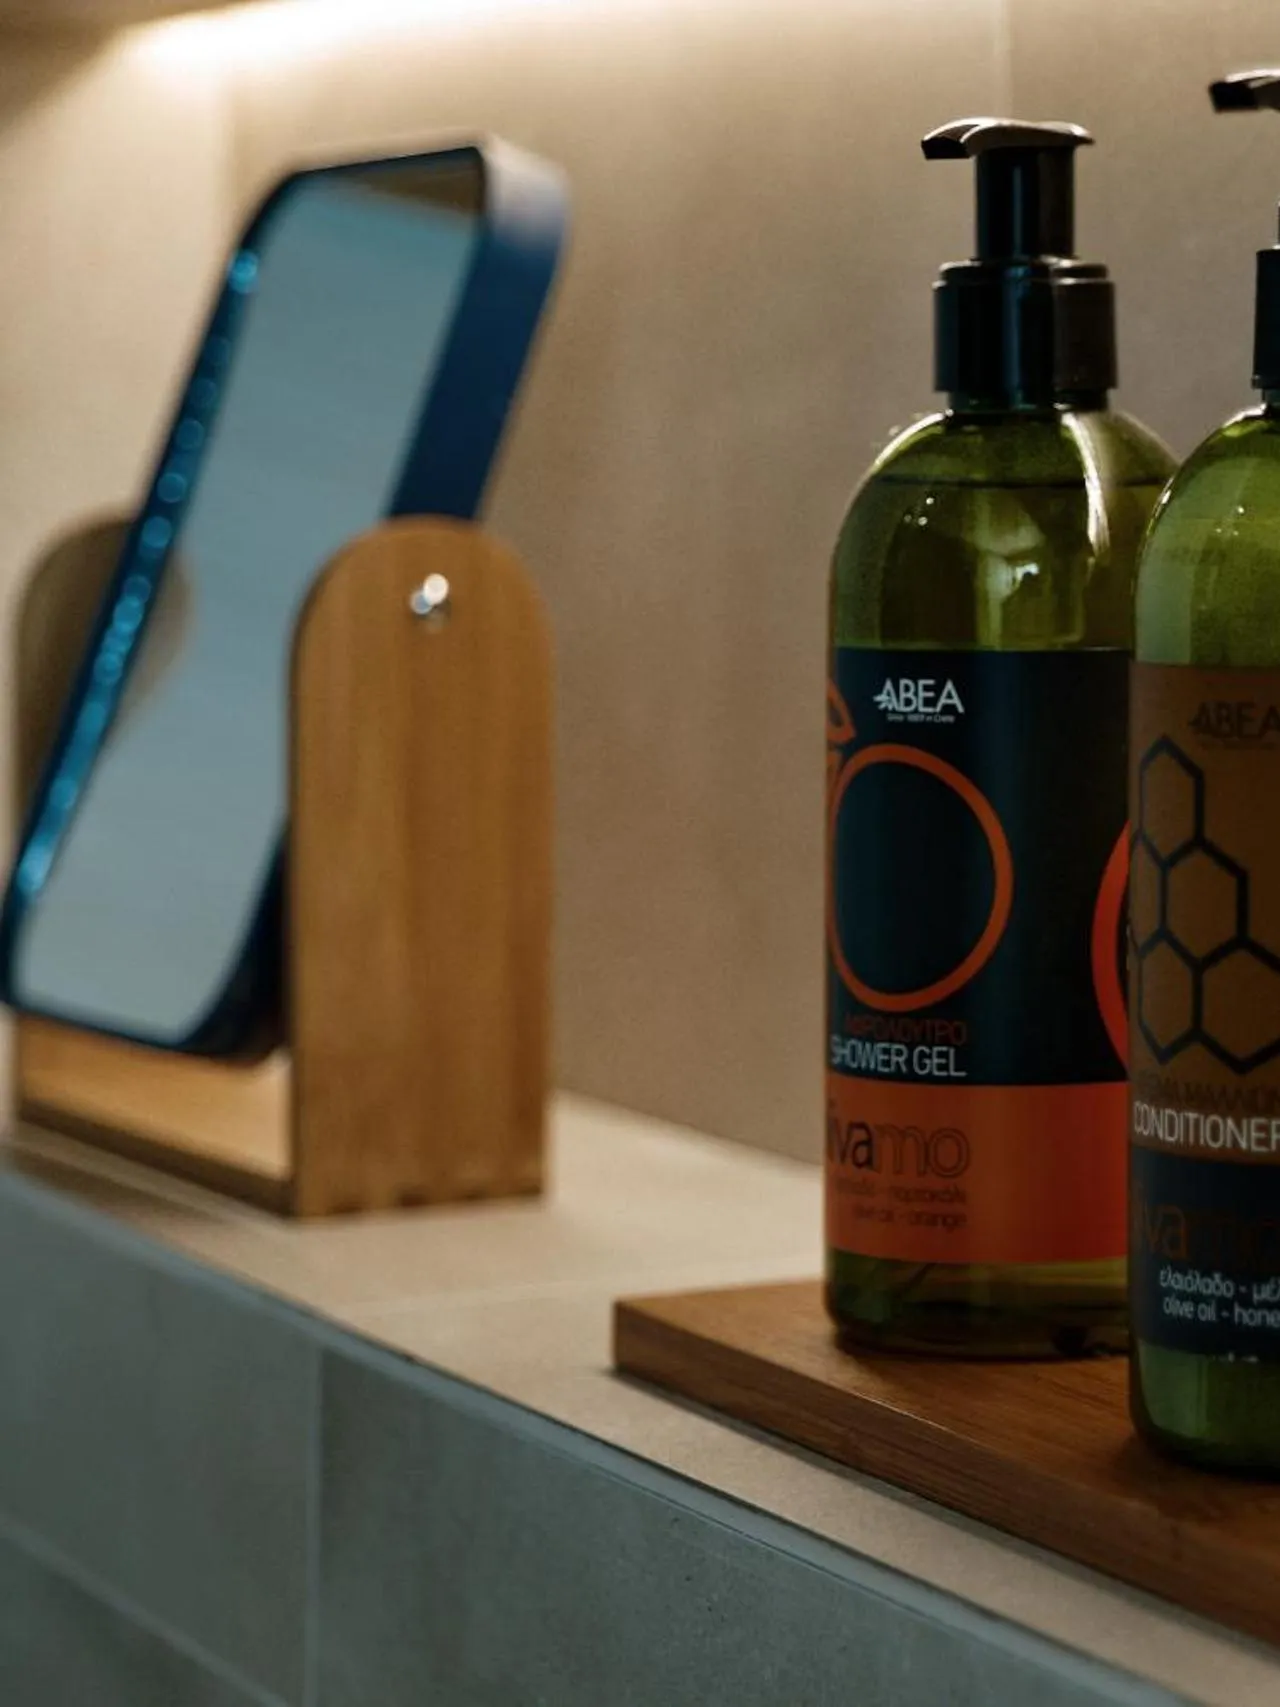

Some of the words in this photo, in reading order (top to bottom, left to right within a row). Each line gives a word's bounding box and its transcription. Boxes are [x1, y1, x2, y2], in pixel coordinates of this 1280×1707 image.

[872, 678, 965, 714] ABEA
[831, 1033, 909, 1073] SHOWER
[912, 1045, 968, 1077] GEL
[1197, 1302, 1216, 1322] oil
